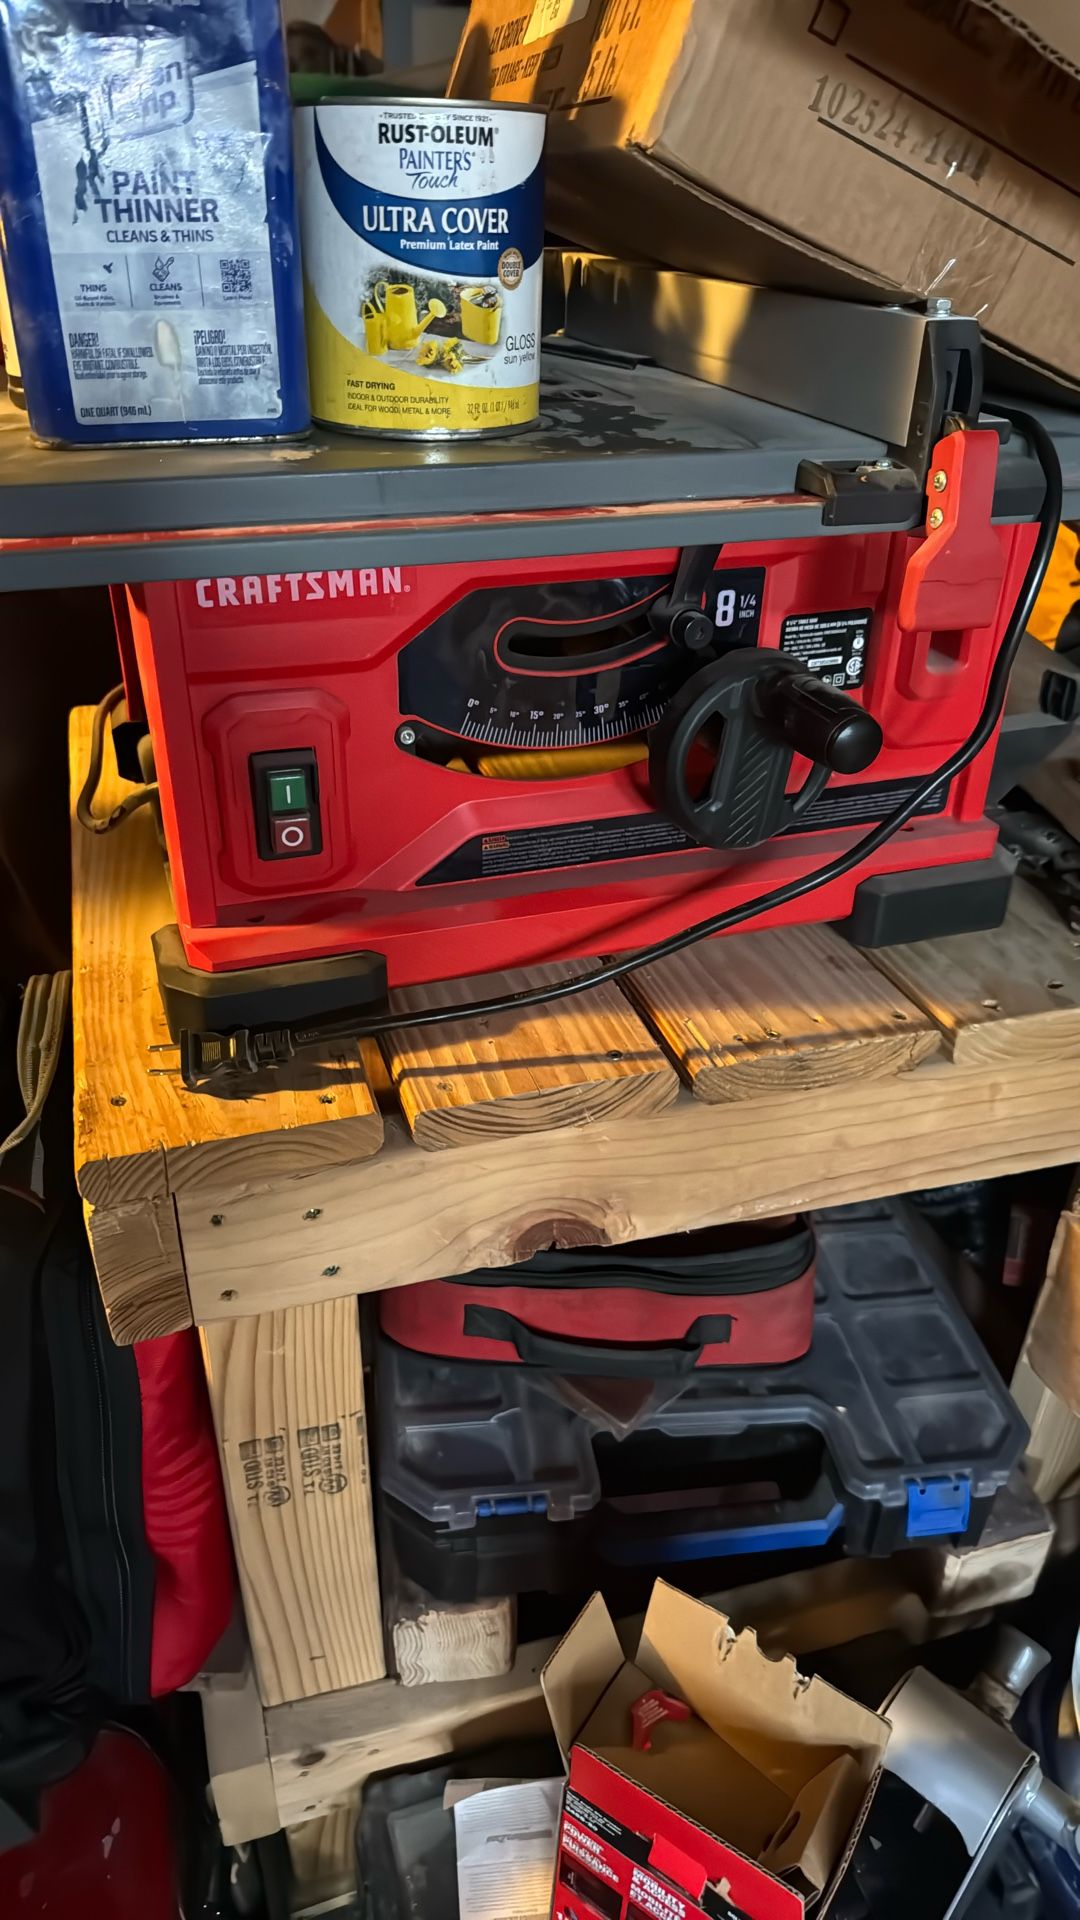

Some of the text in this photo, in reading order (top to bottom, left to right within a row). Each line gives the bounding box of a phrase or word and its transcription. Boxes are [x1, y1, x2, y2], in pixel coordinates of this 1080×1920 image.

[378, 123, 494, 147] RUST-OLEUM
[112, 169, 196, 196] PAINT
[405, 171, 459, 189] Touch
[94, 198, 220, 223] THINNER
[363, 205, 509, 234] ULTRA COVER
[107, 230, 214, 243] CLEANS & THINS
[400, 238, 499, 250] Premium Latex Paint
[501, 261, 521, 269] DOUBLE
[80, 284, 107, 292] THINS
[150, 283, 183, 292] CLEANS
[68, 332, 99, 347] DANGER!
[505, 332, 535, 352] GLOSS
[504, 353, 535, 366] sun yellow
[347, 380, 395, 390] FAST DRYING
[376, 394, 408, 403] OUTDOOR
[410, 396, 449, 404] DURABILITY
[80, 407, 94, 418] ONE
[96, 406, 119, 417] QUART
[120, 406, 136, 418] (946
[364, 403, 377, 412] FOR
[402, 407, 424, 415] METAL
[431, 407, 451, 415] MORE
[195, 566, 401, 608] CRAFTSMAN
[715, 589, 756, 627] 8 1/4
[739, 609, 755, 619] INCH
[530, 710, 544, 720] 15°
[594, 703, 609, 715] 30°
[300, 1447, 322, 1477] STUD
[633, 1866, 685, 1908] MOBILITY
[643, 1884, 686, 1918] ACCESS
